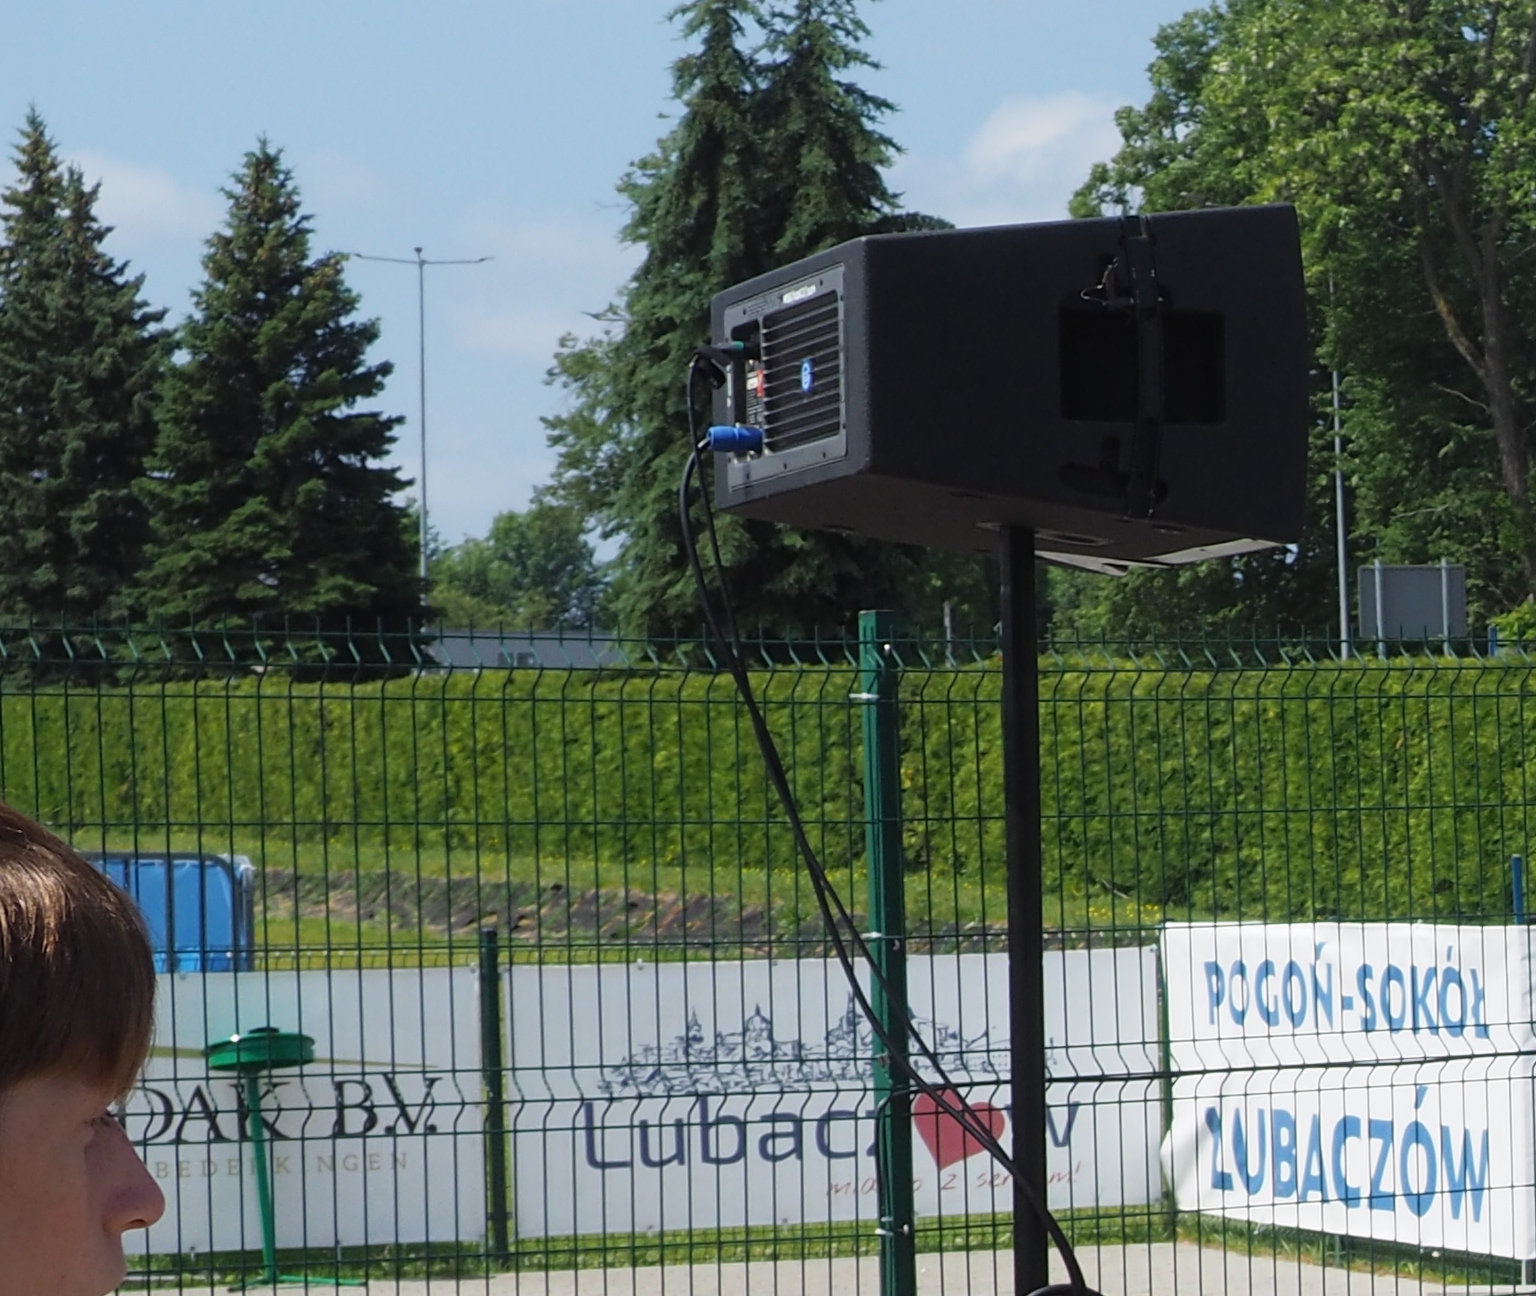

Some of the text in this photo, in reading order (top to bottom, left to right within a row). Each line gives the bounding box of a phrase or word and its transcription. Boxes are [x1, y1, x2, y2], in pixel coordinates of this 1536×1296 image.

[1203, 941, 1491, 1039] POGOŃ-SOKÓŁ
[331, 1074, 443, 1136] B.V.
[155, 1152, 408, 1179] BEDEKNGEN
[1204, 1085, 1490, 1223] LUBACZÓW
